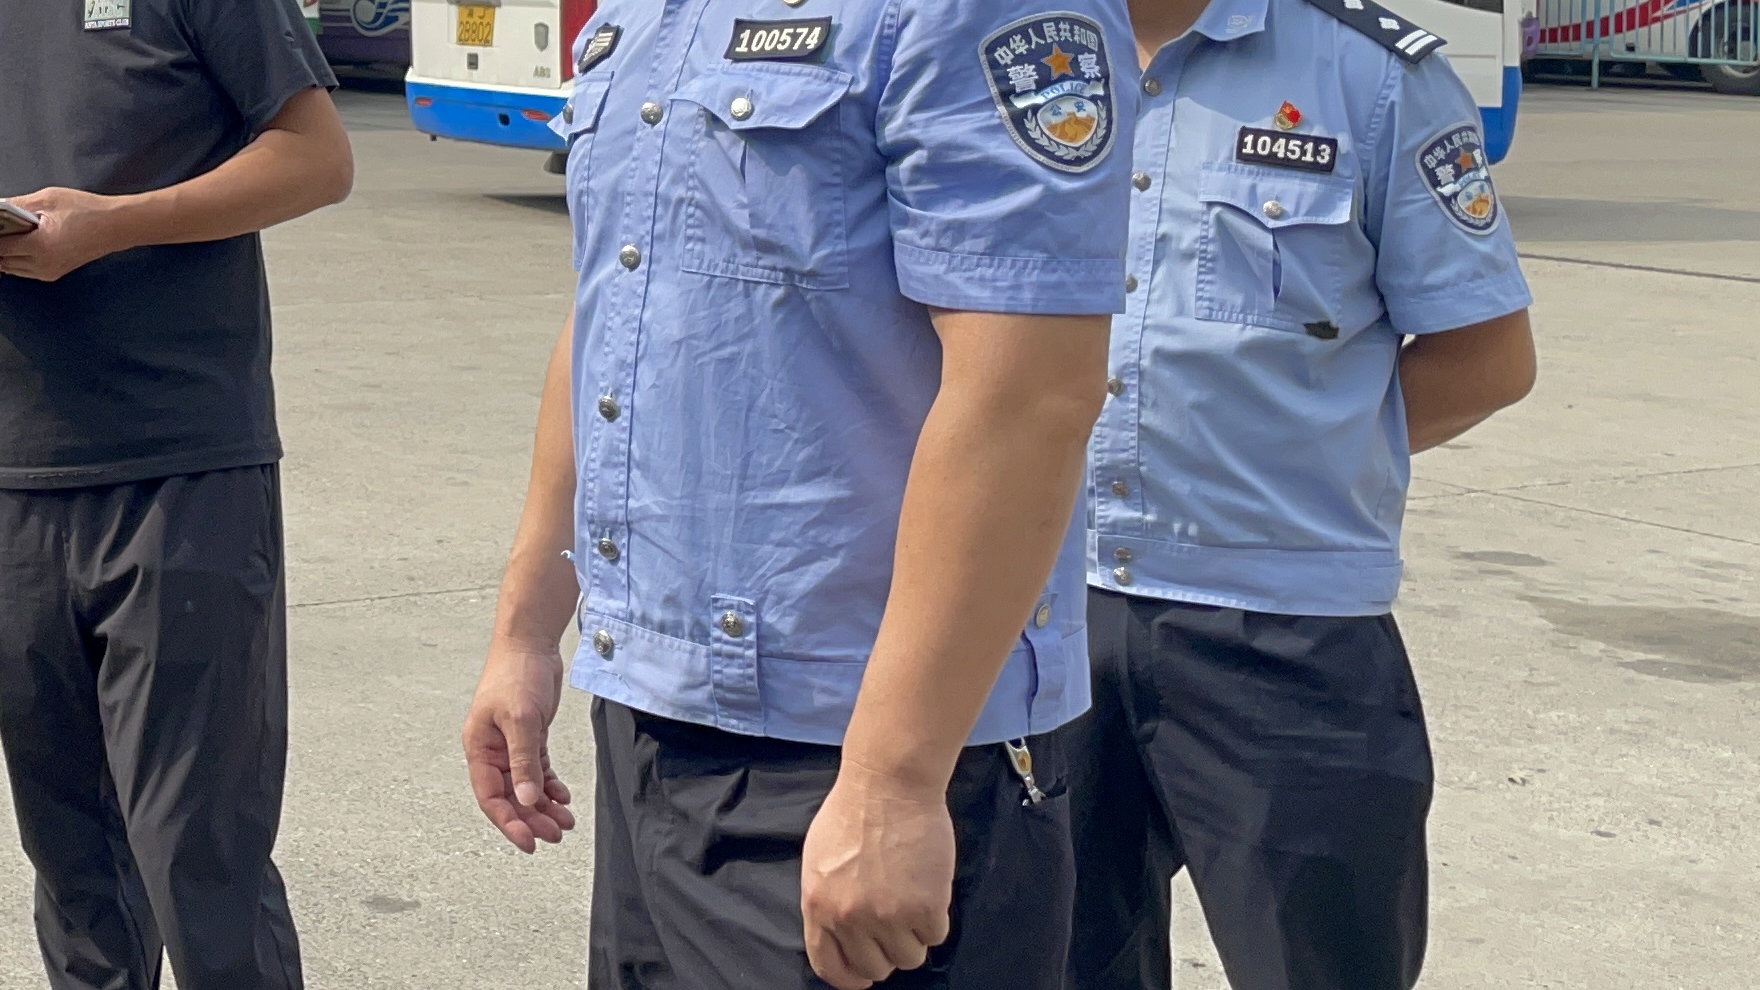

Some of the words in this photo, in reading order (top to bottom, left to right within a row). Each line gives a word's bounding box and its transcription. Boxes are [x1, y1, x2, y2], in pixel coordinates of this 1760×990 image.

[734, 26, 822, 53] 100574
[994, 20, 1098, 66] 中华人民共和国
[1241, 133, 1331, 164] 104513
